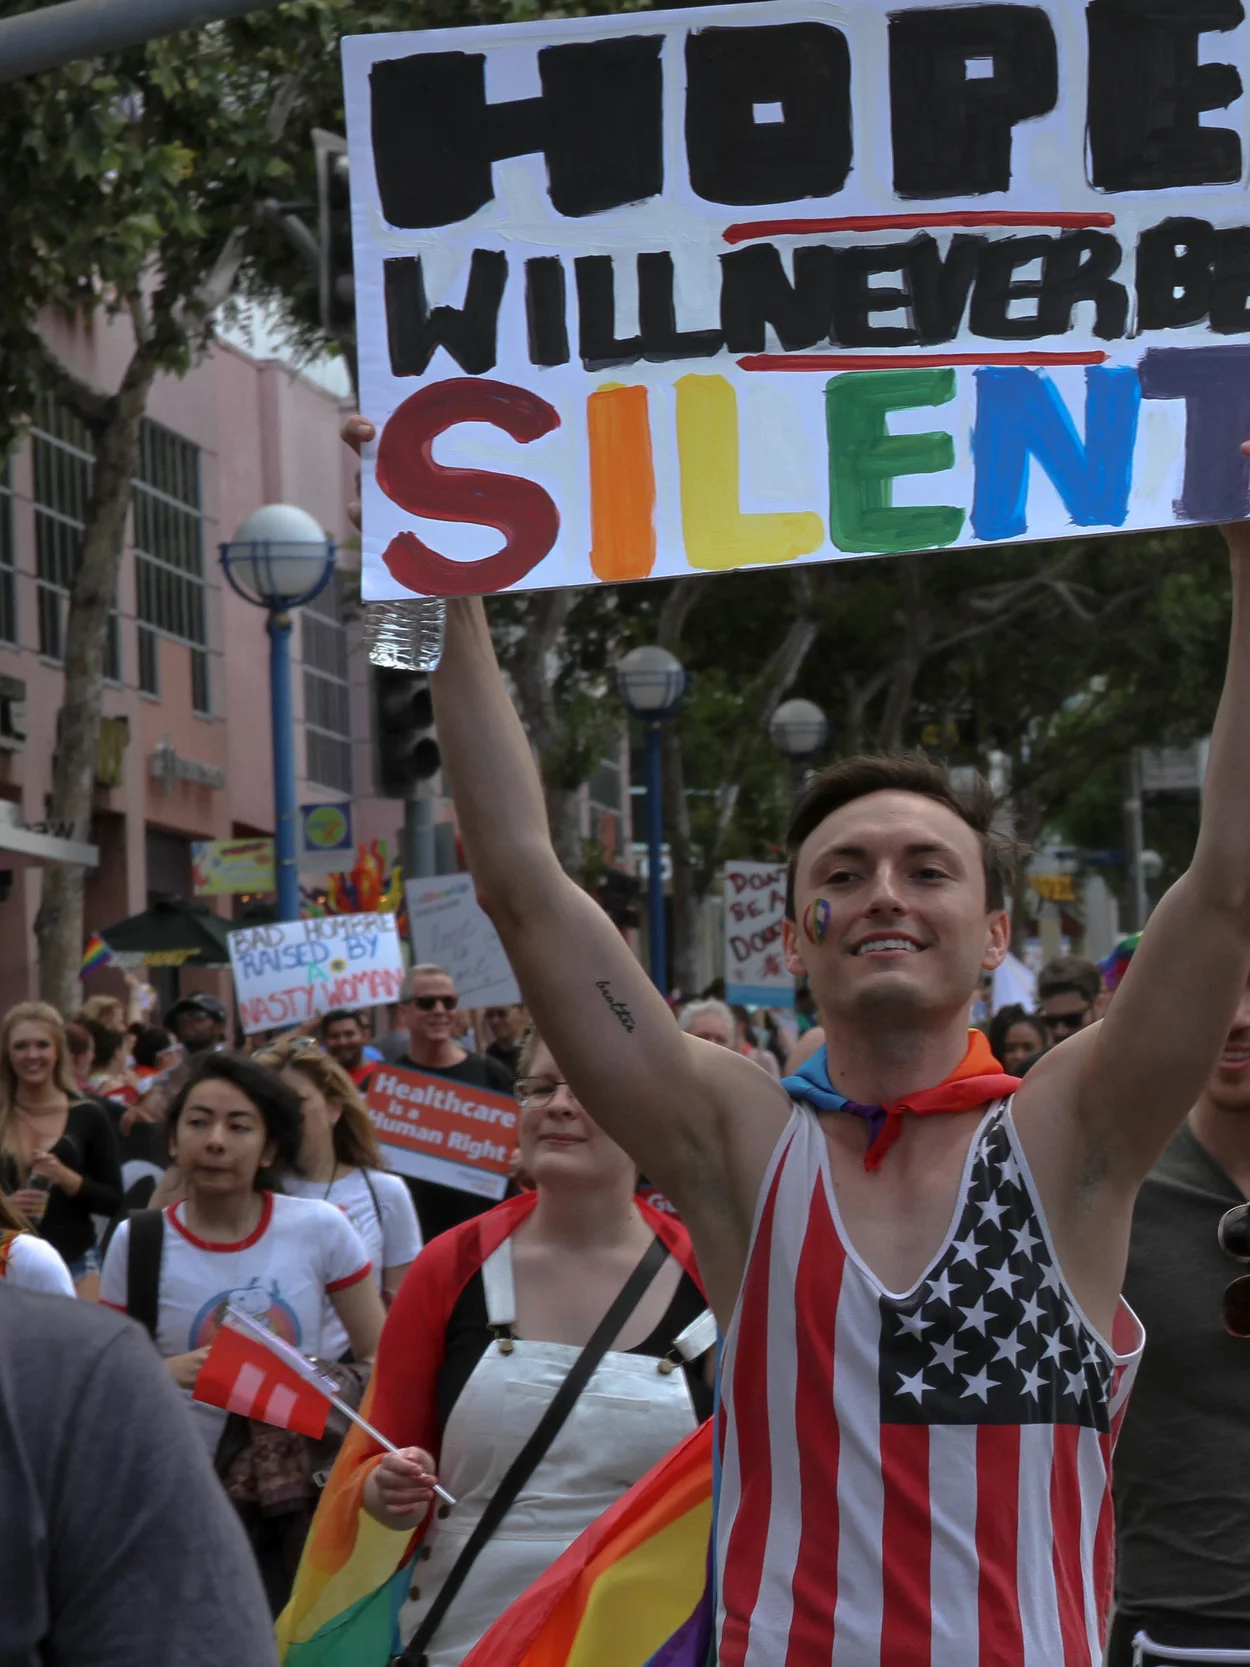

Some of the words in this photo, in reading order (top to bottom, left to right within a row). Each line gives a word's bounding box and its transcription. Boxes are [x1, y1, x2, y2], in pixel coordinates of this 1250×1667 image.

[369, 0, 1246, 229] HOPE
[383, 248, 727, 377] WILL
[719, 227, 1130, 353] NEVER
[230, 924, 286, 954] BAD
[303, 912, 397, 944] HOMBRE
[237, 940, 331, 980] RAISED
[341, 933, 380, 960] BY
[307, 961, 331, 985] A
[238, 983, 317, 1028] NASTY
[322, 967, 405, 1008] WOMAN
[595, 980, 636, 1034] brother
[374, 1071, 518, 1129] Healthcare
[406, 1107, 421, 1121] a
[368, 1107, 444, 1145] Human
[447, 1130, 508, 1163] Right
